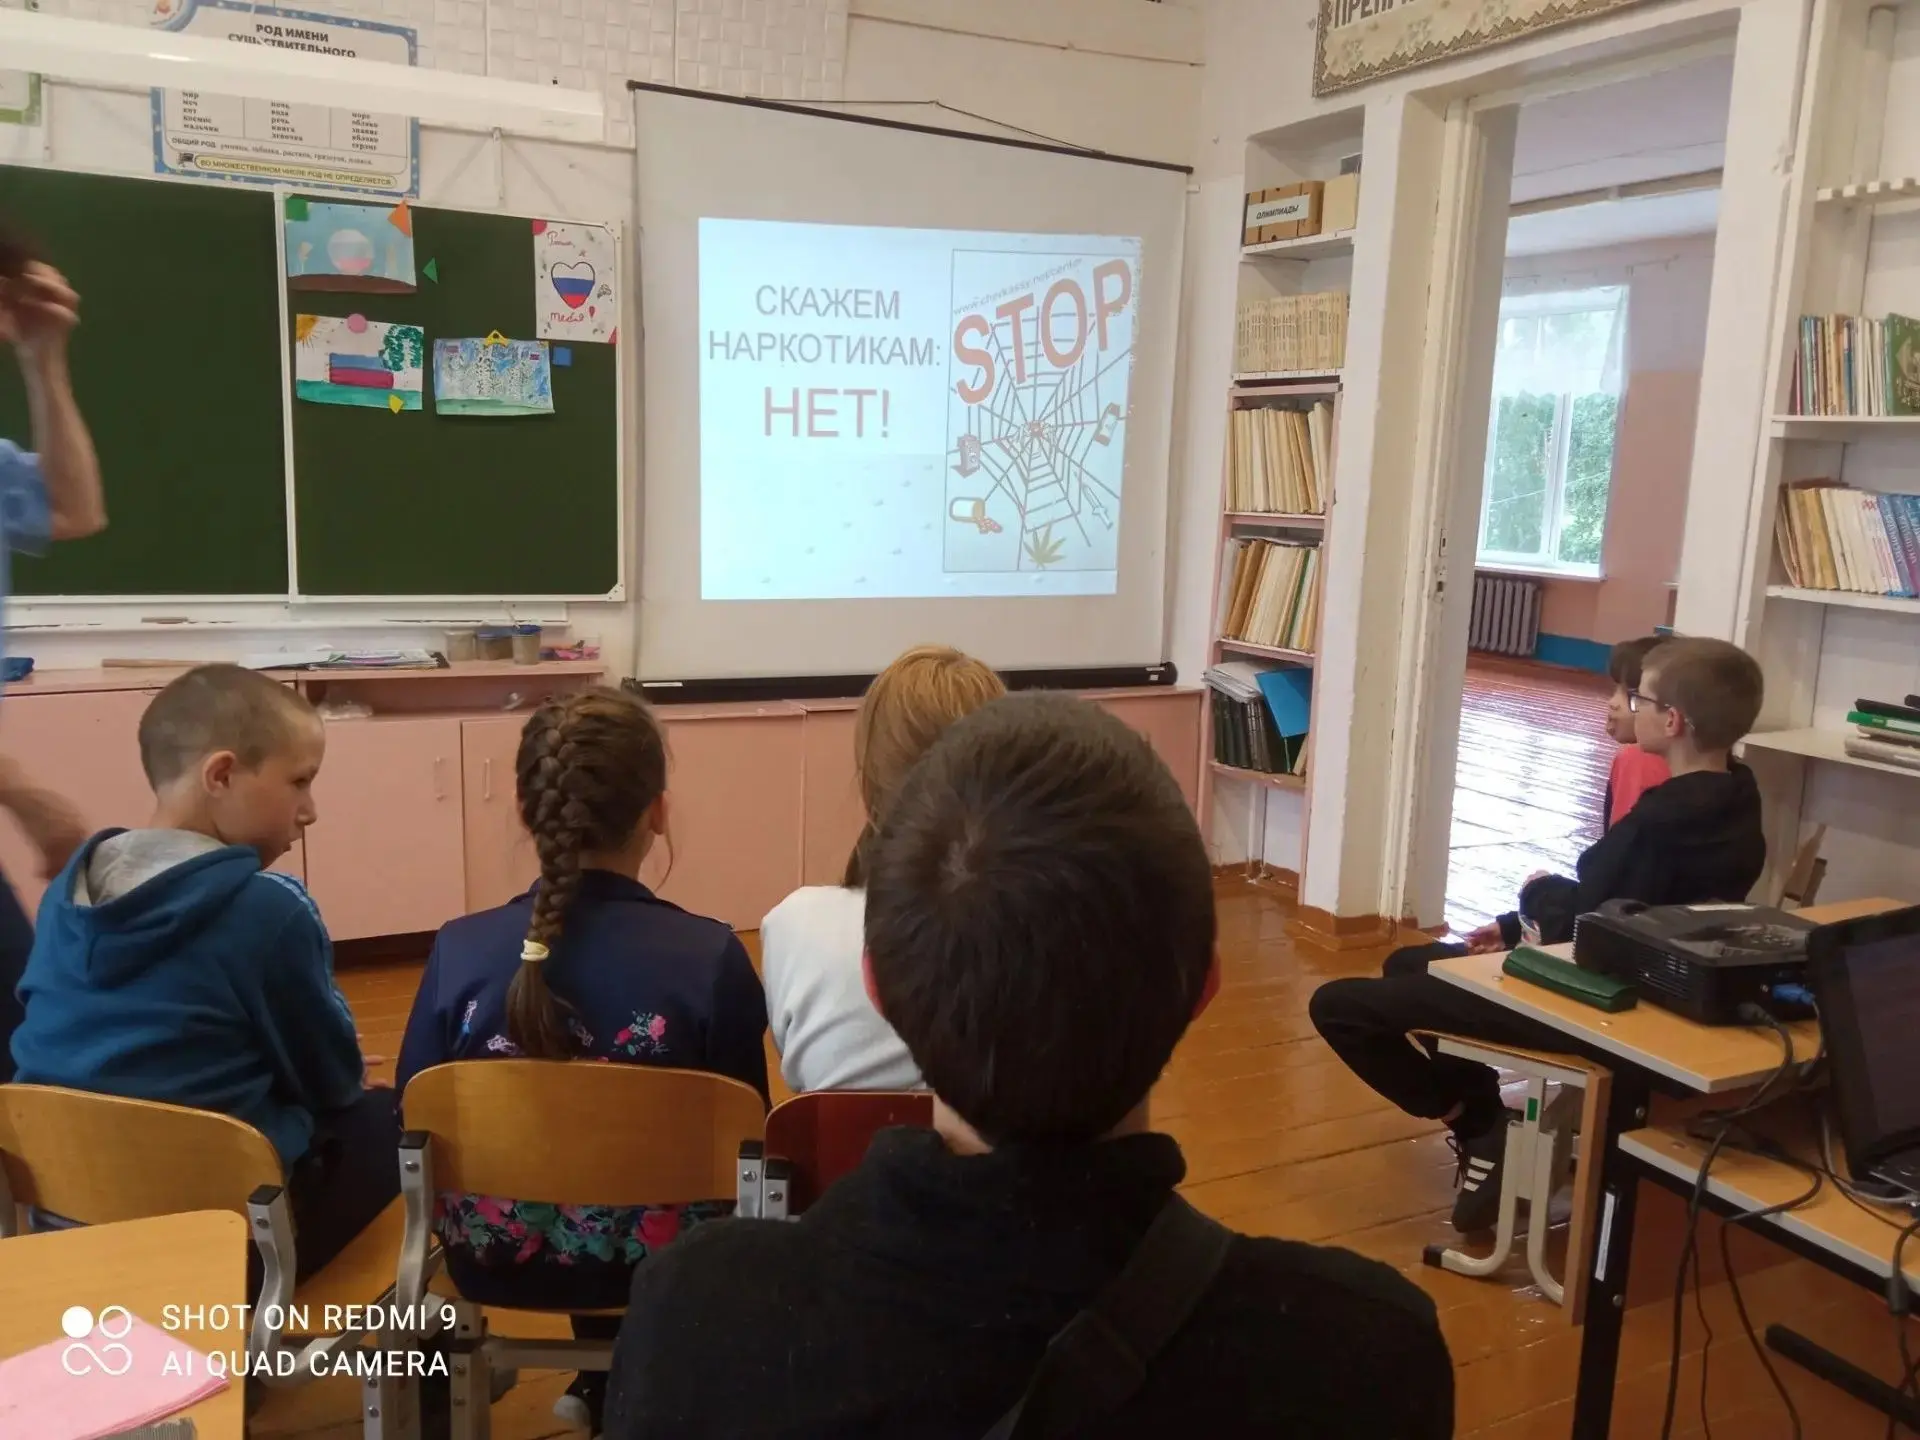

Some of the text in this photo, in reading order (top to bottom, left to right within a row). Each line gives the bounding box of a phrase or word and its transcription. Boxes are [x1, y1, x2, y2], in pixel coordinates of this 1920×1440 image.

[256, 24, 329, 42] РОД ИМЕНИ
[171, 137, 199, 146] ОБЩИЙ
[213, 161, 281, 173] МНОЖЕСТВЕННОМ
[308, 170, 322, 178] РОД
[1256, 204, 1299, 219] ОЛИМПИАДЫ
[755, 284, 900, 320] СКАЖЕМ
[953, 258, 1132, 405] STOP
[708, 330, 941, 366] НАРКОТИКАМ:
[763, 386, 890, 439] НЕТ!
